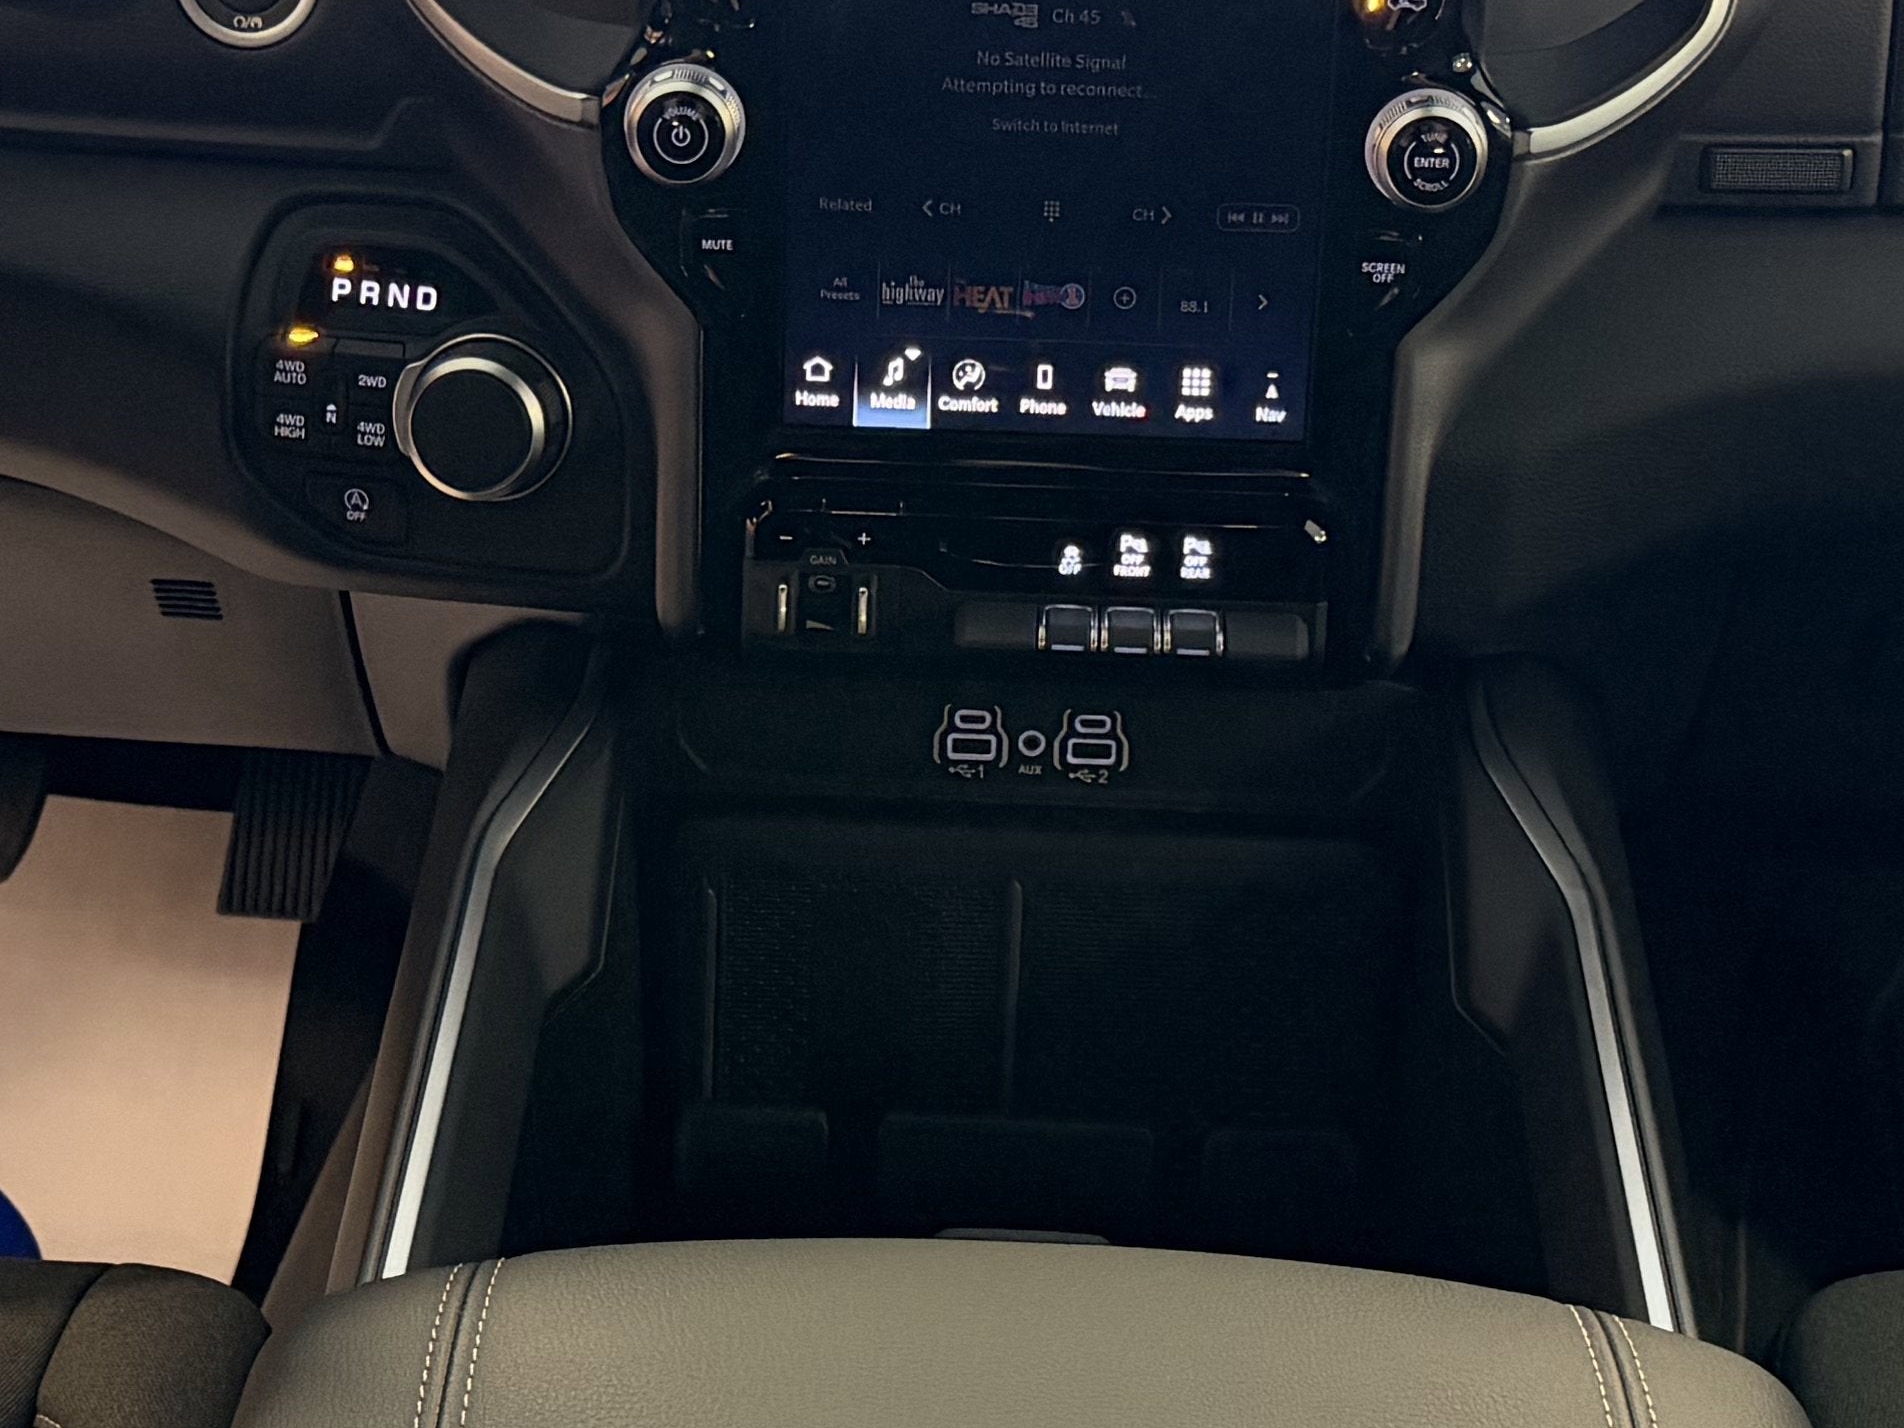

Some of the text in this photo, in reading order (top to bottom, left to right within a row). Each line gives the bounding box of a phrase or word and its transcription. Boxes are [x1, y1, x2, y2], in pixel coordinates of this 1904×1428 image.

[1052, 8, 1102, 25] Ch 45
[977, 50, 1127, 73] No Satellite Signal
[942, 78, 1036, 98] Attempting
[1040, 82, 1056, 96] to
[992, 118, 1119, 136] Switch to Internet
[1414, 157, 1451, 169] ENTER
[1413, 178, 1449, 192] SCROLL
[819, 197, 873, 213] Related
[939, 202, 962, 216] CH
[1132, 208, 1155, 222] CH
[701, 239, 734, 251] MUTE
[1361, 262, 1405, 274] SCREEN
[1373, 273, 1394, 283] OFF
[882, 281, 945, 306] highway
[276, 360, 305, 372] 4WD
[274, 372, 306, 385] AUTO
[358, 375, 387, 388] 2WD
[795, 390, 1287, 423] Home Media Comfort Phone Vehicle Apps Nav
[277, 413, 305, 426] 4WD
[274, 425, 305, 439] HIGH
[357, 422, 385, 435] 4WD
[357, 433, 385, 447] LOW
[347, 511, 366, 521] OFF
[810, 555, 837, 565] GAIN
[1121, 554, 1145, 565] OFF
[1183, 555, 1208, 567] OFF
[1058, 563, 1082, 576] OFF
[1113, 565, 1151, 577] FRONT
[1018, 765, 1042, 775] AUX
[1098, 772, 1109, 784] 2
